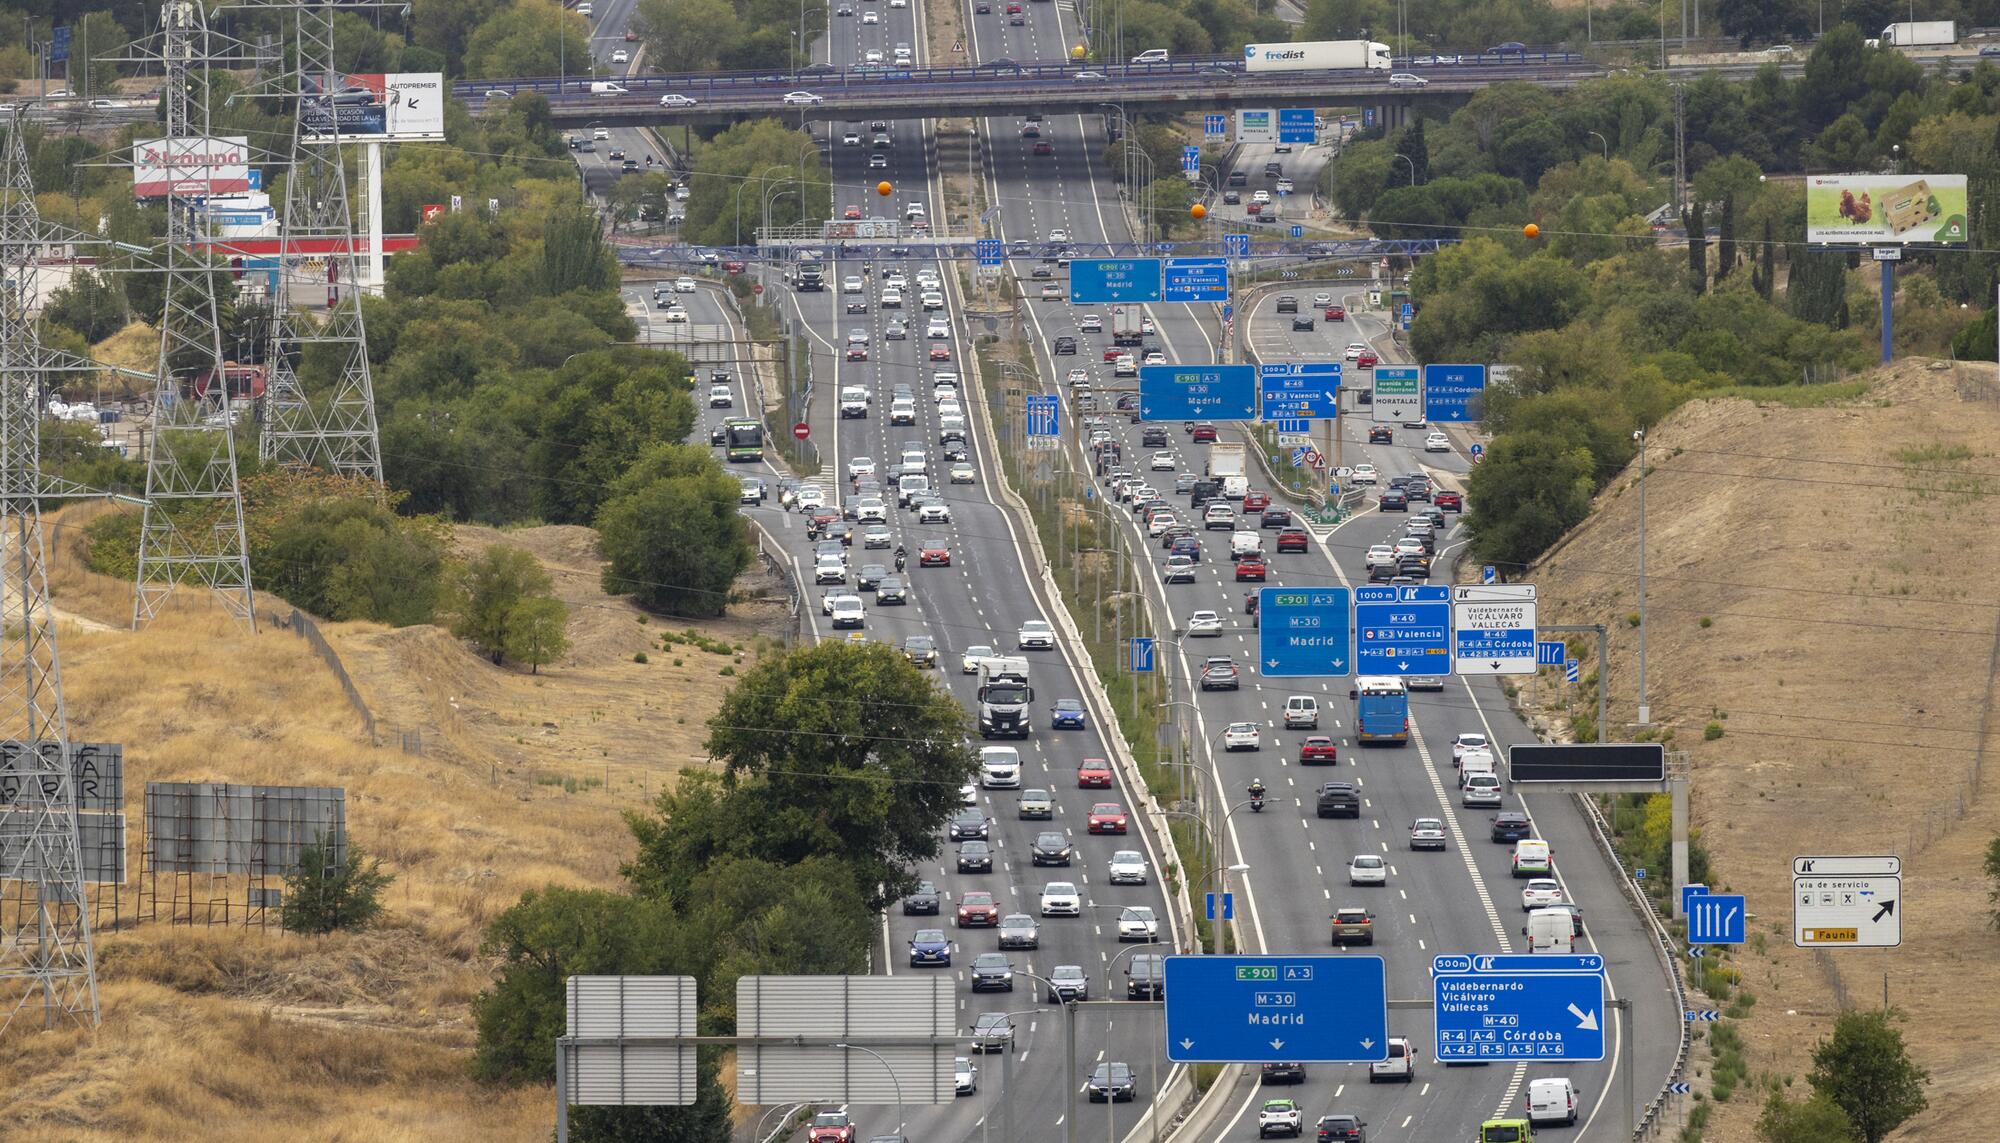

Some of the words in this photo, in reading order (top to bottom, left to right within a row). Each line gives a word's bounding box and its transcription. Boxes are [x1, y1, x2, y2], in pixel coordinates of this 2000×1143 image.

[1265, 50, 1304, 60] fredist
[1175, 374, 1200, 382] E-901
[1203, 374, 1220, 382] A-3
[1189, 385, 1208, 393] M-30
[1188, 396, 1221, 405] Madrid
[1276, 596, 1307, 604] E-901
[1313, 595, 1333, 604] A-3
[1468, 612, 1523, 620] VICÁLVARO
[1291, 618, 1319, 626] M-30
[1397, 630, 1441, 638] Valencia
[1290, 636, 1334, 646] Madrid
[1494, 640, 1533, 648] Córdoba
[1819, 931, 1856, 939] Faunia
[1238, 968, 1275, 978] E-901
[1287, 968, 1311, 978] A-3
[1441, 982, 1524, 991] Valdebernardo
[1257, 995, 1294, 1004] M-30
[1441, 991, 1495, 1001] Vicálvaro
[1441, 1002, 1489, 1012] Vallecas
[1248, 1013, 1304, 1025] Madrid
[1485, 1016, 1517, 1025] M-40
[1442, 1032, 1465, 1041] R-4
[1472, 1032, 1495, 1041] A-4
[1503, 1030, 1562, 1041] Córdoba
[1443, 1045, 1474, 1054] A-42
[1481, 1045, 1503, 1054] R-5
[1510, 1045, 1533, 1054] A-5
[1539, 1045, 1562, 1054] A-6
